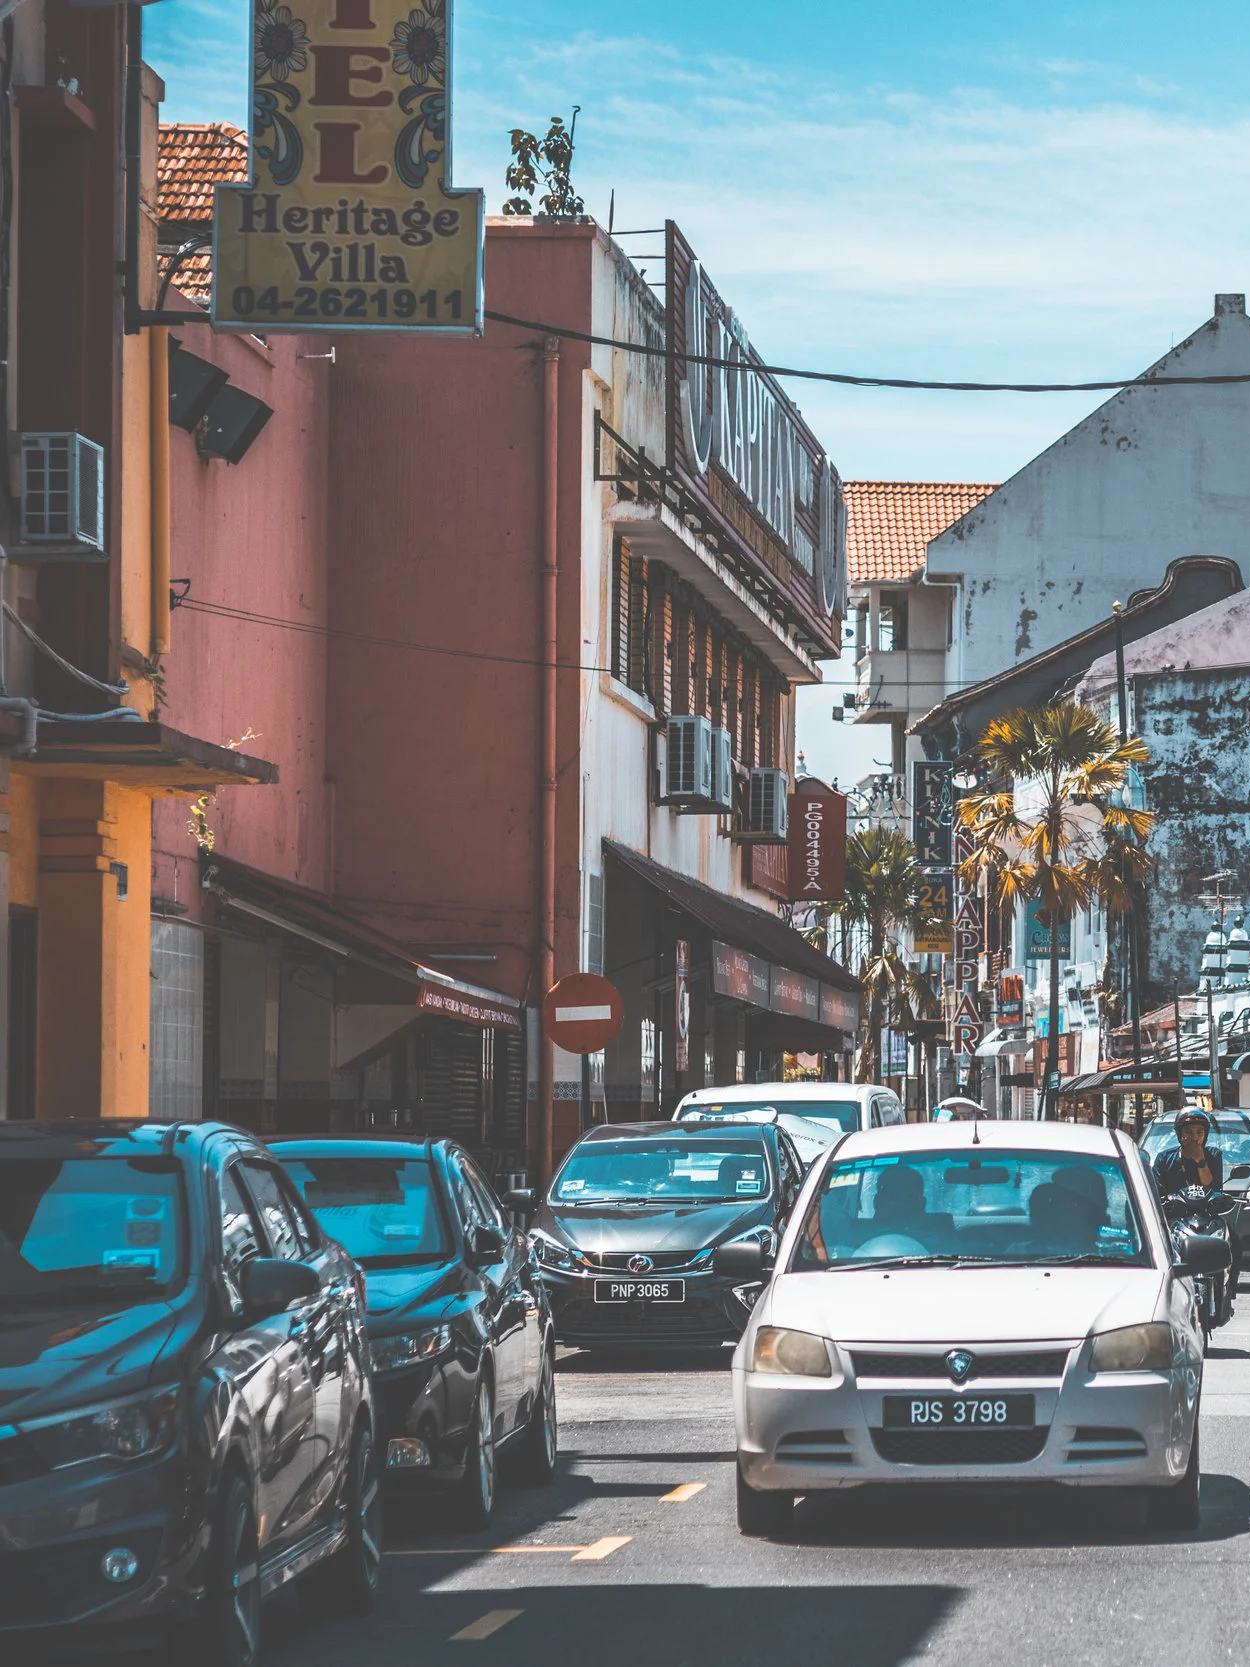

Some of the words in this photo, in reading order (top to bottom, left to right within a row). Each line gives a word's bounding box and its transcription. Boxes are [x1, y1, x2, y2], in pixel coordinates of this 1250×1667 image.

[237, 192, 460, 247] Heritage
[286, 240, 410, 284] Villa
[231, 285, 462, 319] 04-2621911
[923, 768, 944, 861] KLINIK
[919, 885, 949, 908] 24
[790, 1132, 816, 1142] xerox
[611, 1284, 636, 1298] PNP
[637, 1283, 670, 1297] 3065
[910, 1400, 944, 1424] PJS
[953, 1400, 1007, 1423] 3798
